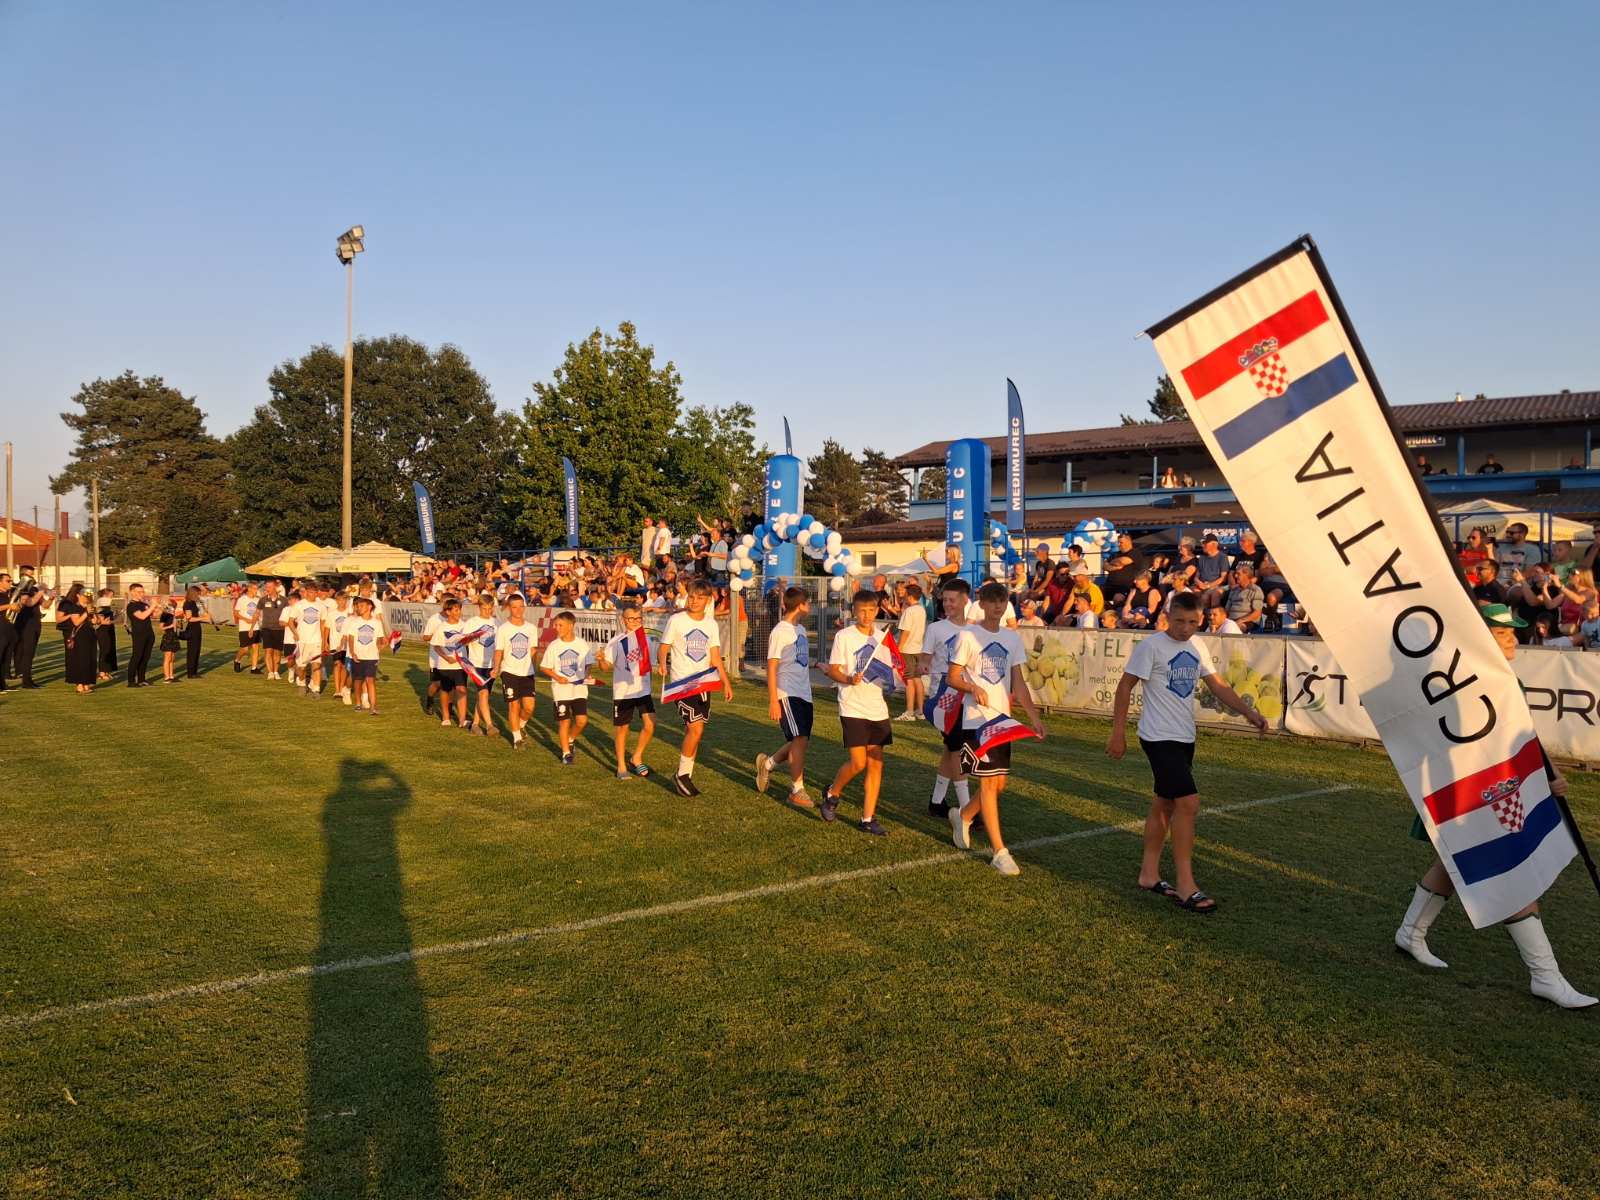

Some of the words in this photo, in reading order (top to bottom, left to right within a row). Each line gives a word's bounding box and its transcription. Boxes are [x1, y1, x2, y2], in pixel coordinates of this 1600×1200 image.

[1294, 431, 1496, 744] CROATIA
[581, 627, 608, 643] FINALE
[1523, 686, 1600, 726] PR
